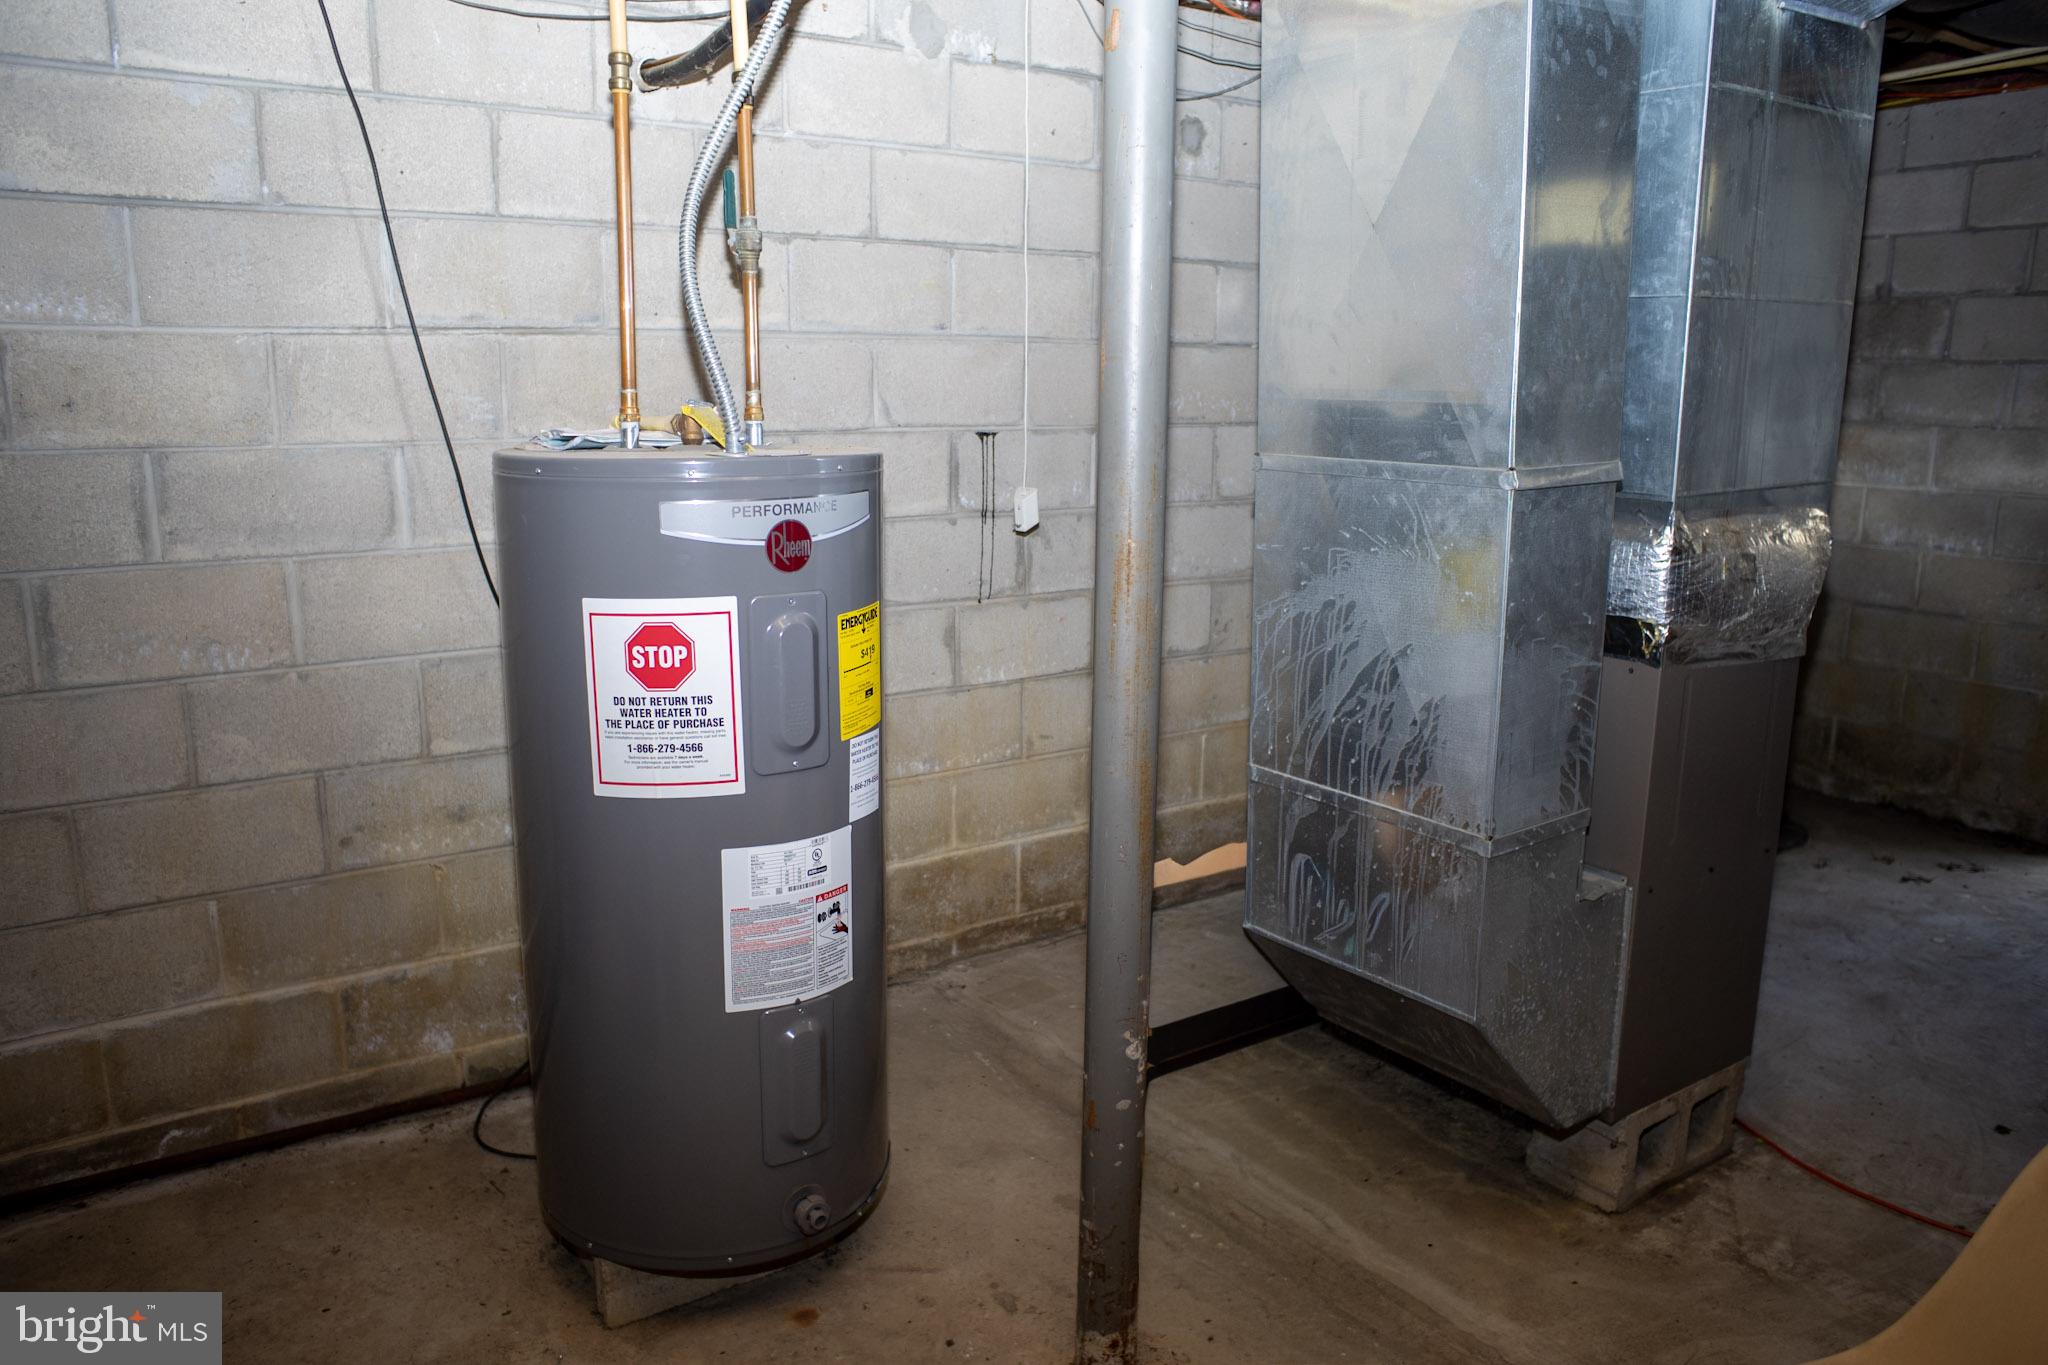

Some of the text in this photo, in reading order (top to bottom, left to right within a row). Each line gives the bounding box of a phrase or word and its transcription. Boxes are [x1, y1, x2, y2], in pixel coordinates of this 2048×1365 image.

[731, 500, 838, 518] PERFORMANCE
[770, 520, 811, 565] Rheem
[631, 645, 688, 669] STOP
[613, 695, 713, 706] DO NOT RETURN THIS
[620, 707, 707, 718] WATER HEATER TO
[605, 718, 725, 730] THE PLACE OF PURCHASE
[627, 743, 704, 754] 1-866-279-4566
